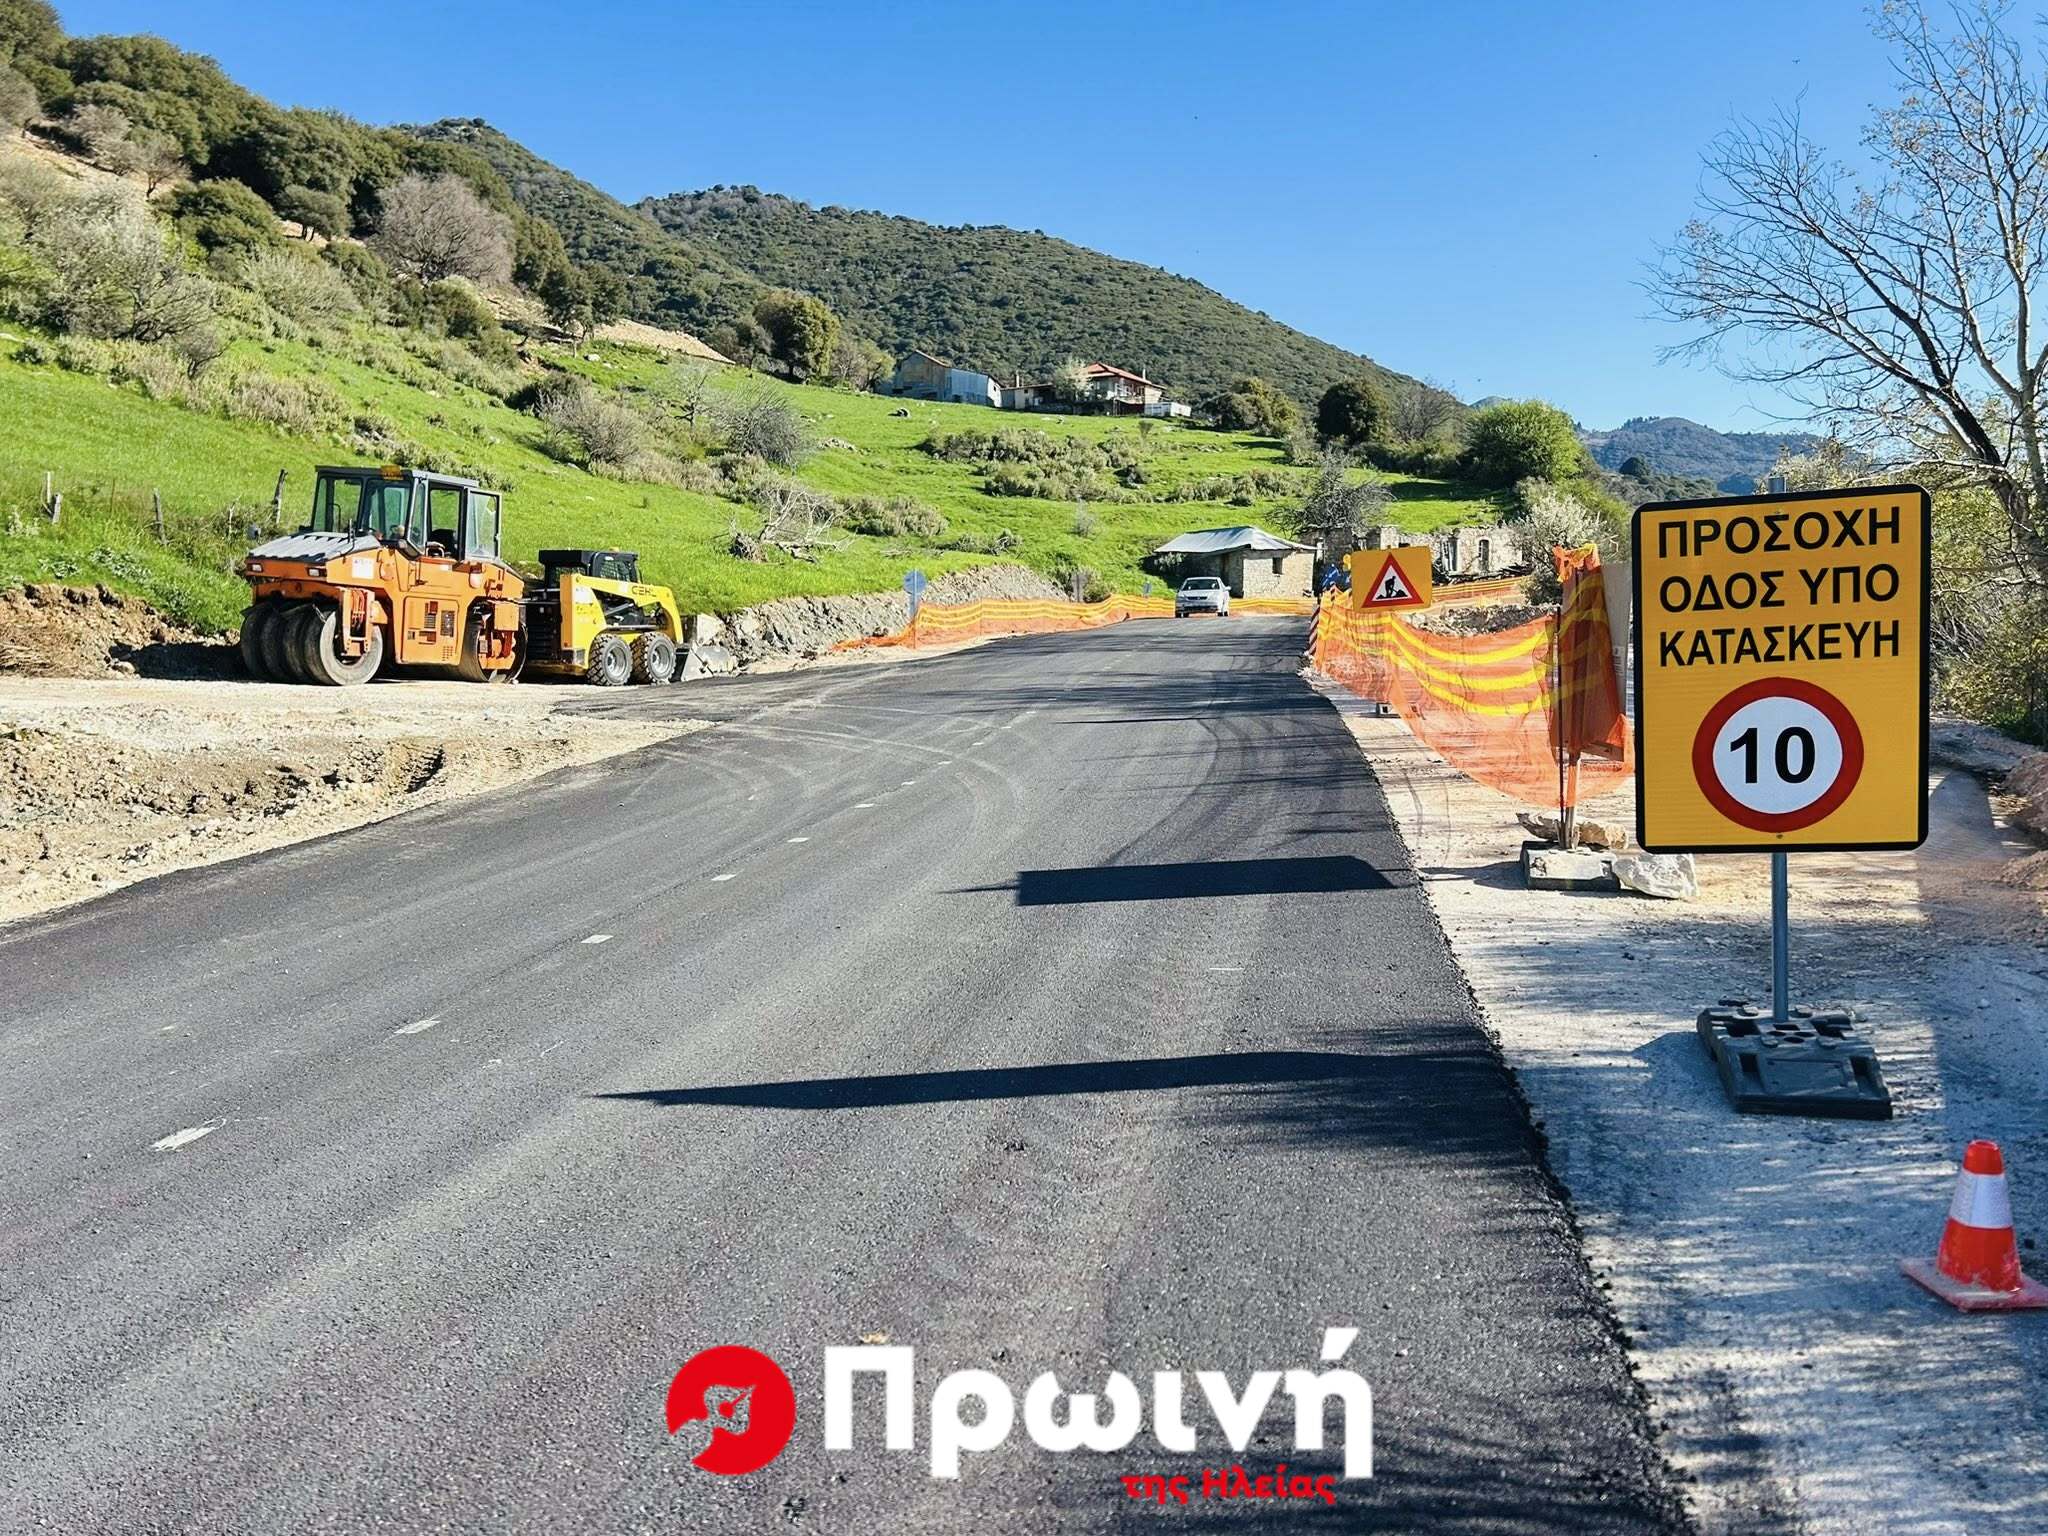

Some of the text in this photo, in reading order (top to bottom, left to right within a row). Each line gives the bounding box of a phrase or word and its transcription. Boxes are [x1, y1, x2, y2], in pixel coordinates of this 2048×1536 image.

[1658, 505, 1901, 559] ΠΡΟΣΟΧΗ
[1659, 563, 1900, 613] ΟΔΟΣ ΥΠΟ
[1659, 619, 1901, 667] ΚΑΤΑΣΚΕΥΗ
[1730, 726, 1816, 784] 10
